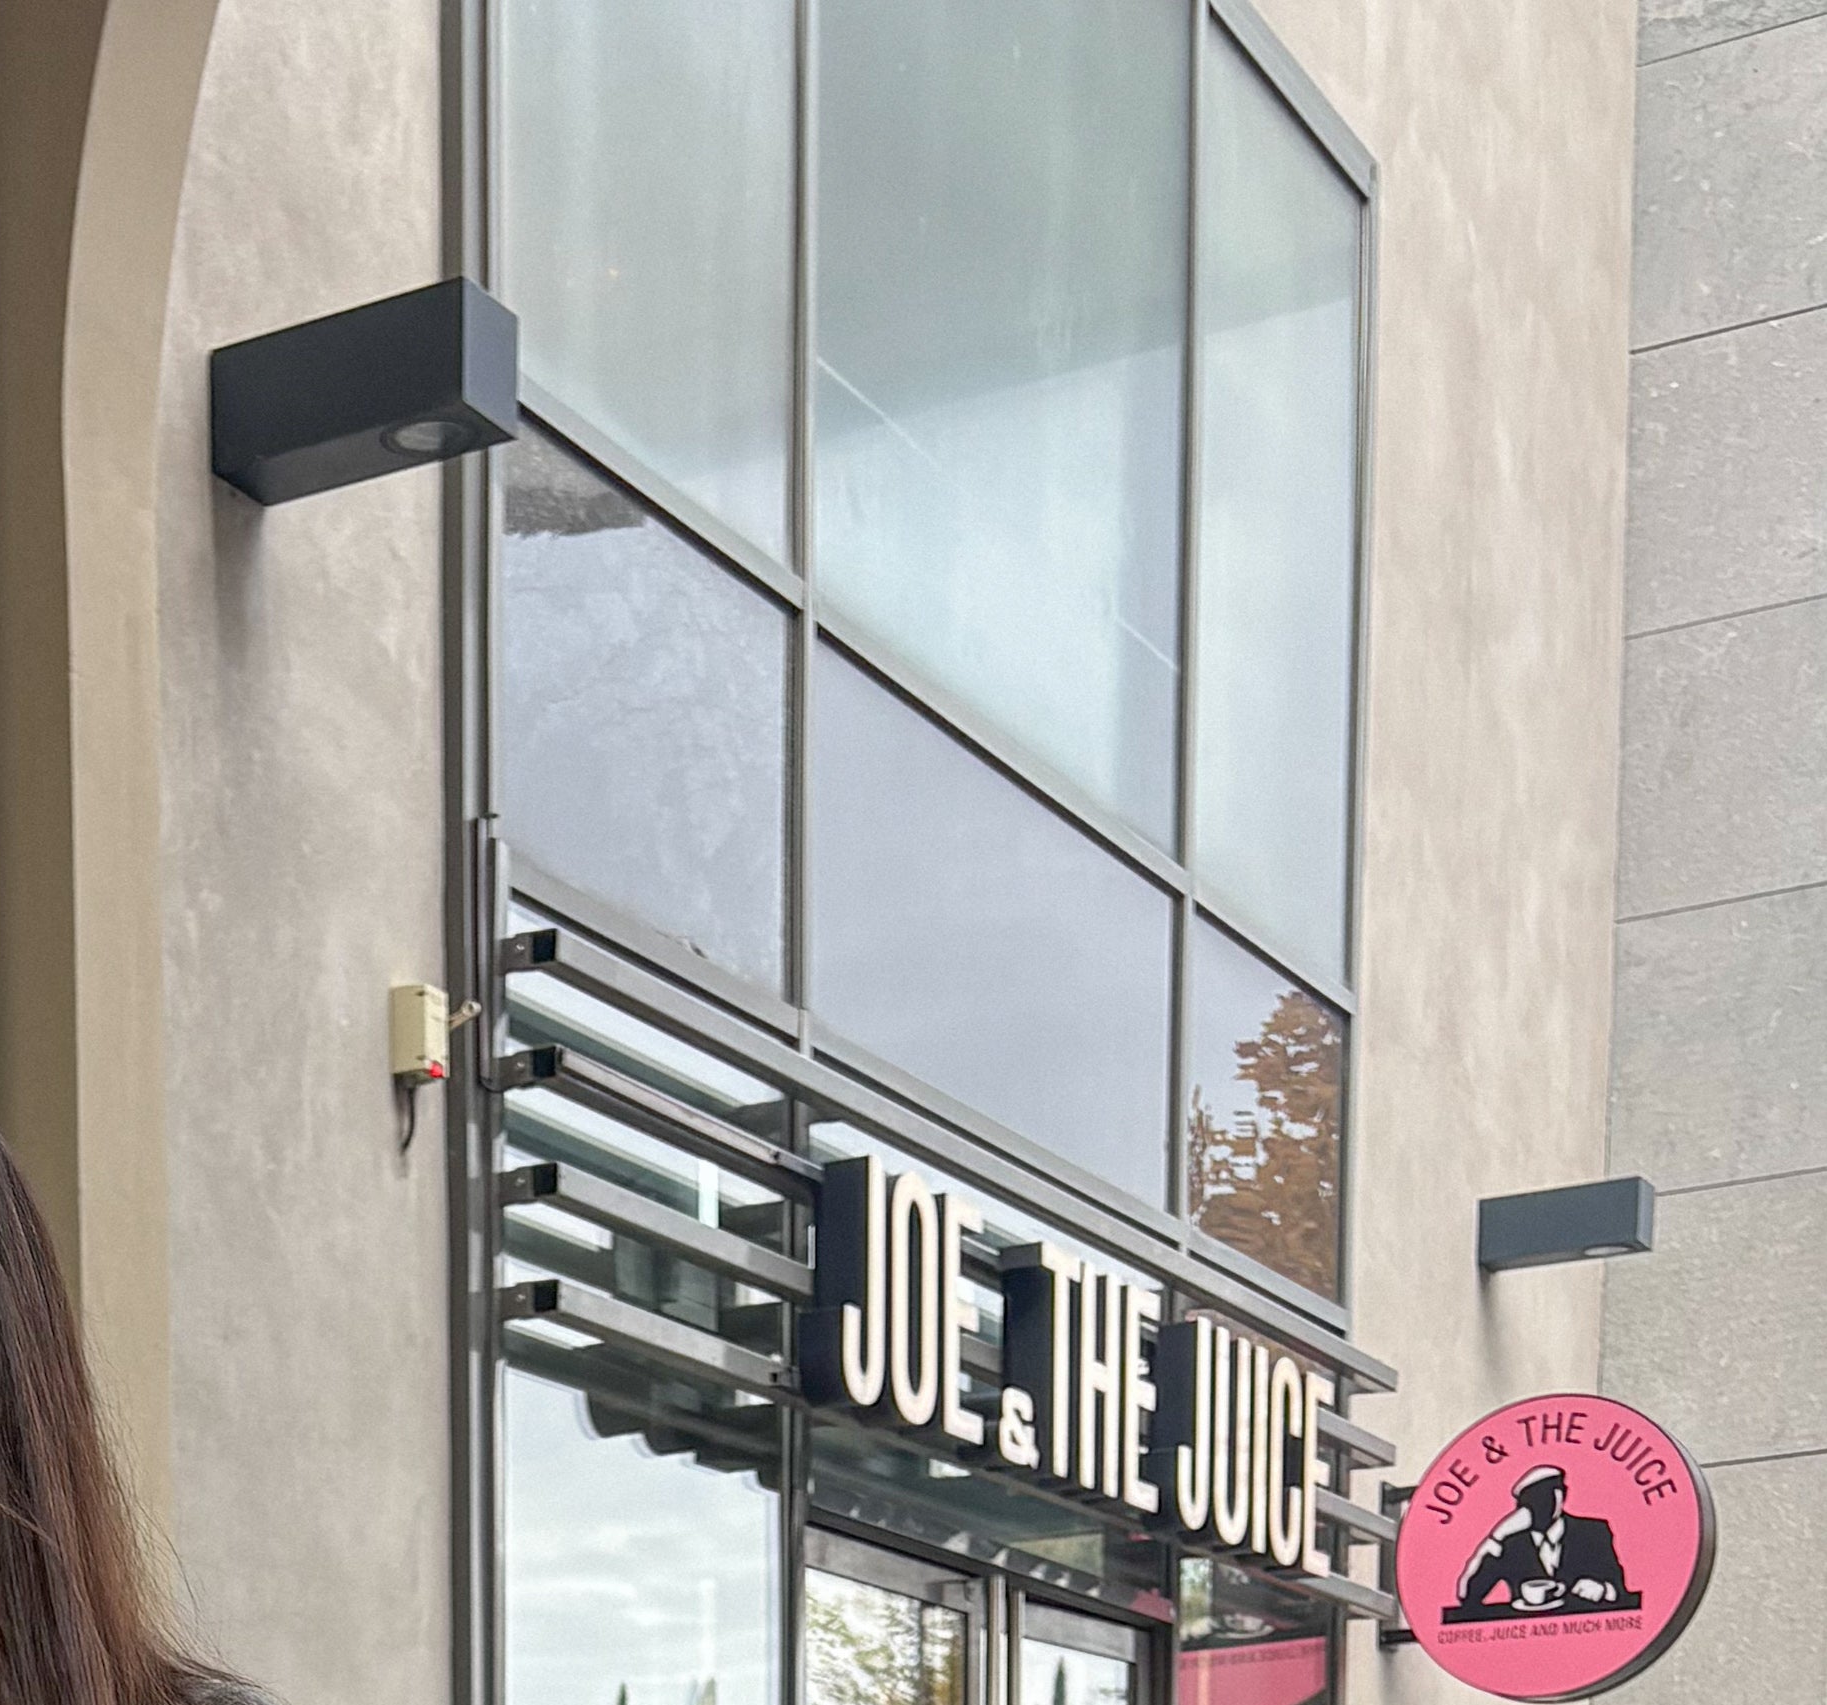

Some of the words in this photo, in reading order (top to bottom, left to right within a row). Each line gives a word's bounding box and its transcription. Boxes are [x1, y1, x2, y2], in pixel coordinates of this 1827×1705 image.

[842, 1155, 984, 1446] JOE
[999, 1386, 1040, 1470] &
[1040, 1242, 1162, 1513] THE
[1177, 1315, 1335, 1578] JUICE
[1426, 1459, 1480, 1525] JOE
[1482, 1435, 1510, 1465] &
[1517, 1412, 1589, 1448] THE
[1593, 1423, 1678, 1506] JUICE
[1489, 1624, 1527, 1641] JUICE
[1530, 1622, 1559, 1637] AND
[1562, 1618, 1602, 1635] MUCH
[1604, 1615, 1643, 1632] MORE
